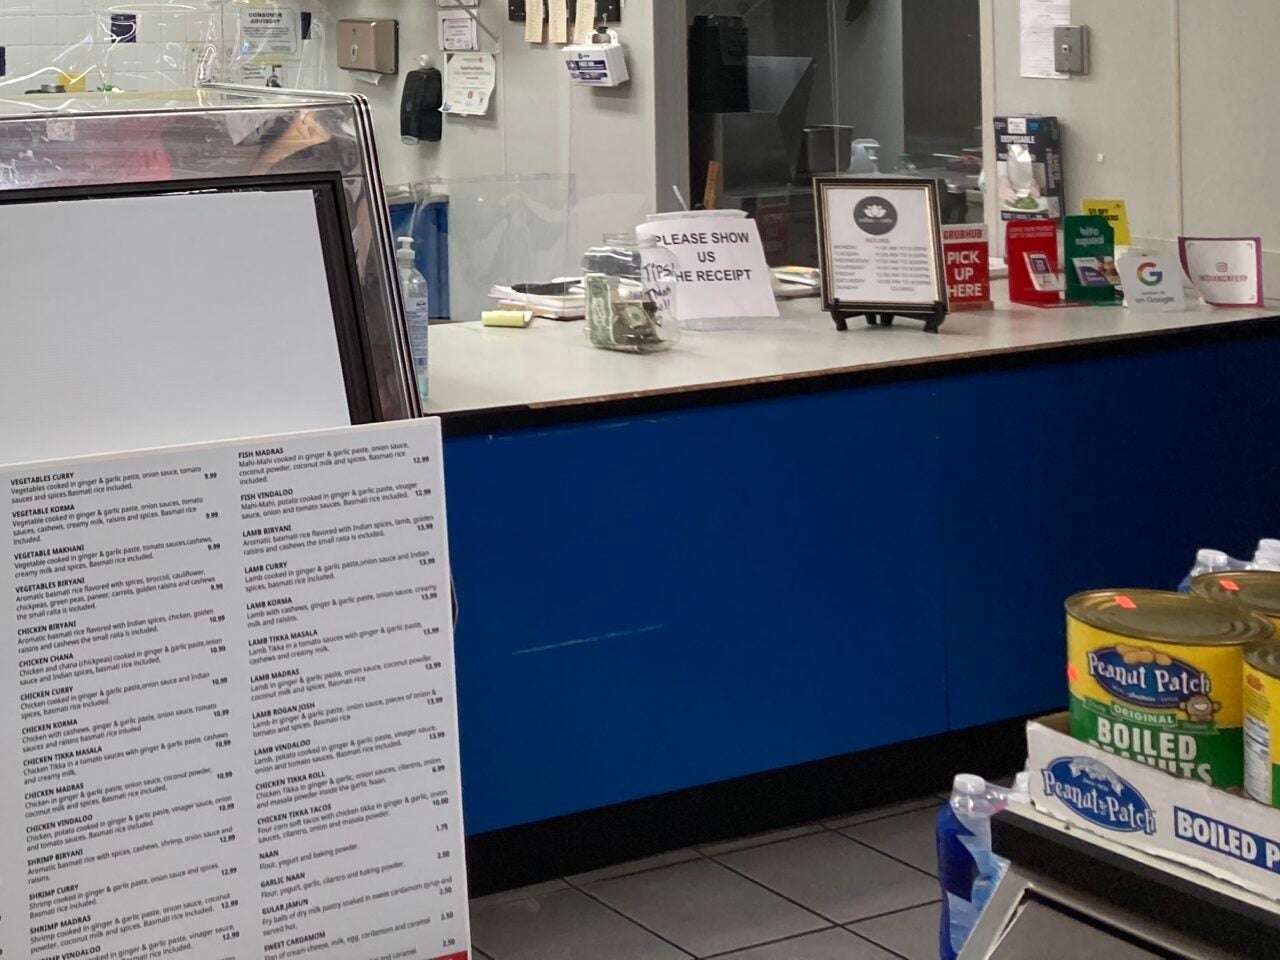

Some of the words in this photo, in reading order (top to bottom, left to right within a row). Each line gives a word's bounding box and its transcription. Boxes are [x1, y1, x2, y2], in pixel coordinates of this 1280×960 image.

[656, 233, 707, 245] PLEASE
[711, 232, 749, 243] SHOW
[943, 229, 983, 239] GRUBHUB
[698, 252, 715, 263] US
[947, 251, 980, 264] PICK
[676, 270, 692, 282] HE
[696, 269, 752, 281] RECEIPT
[954, 268, 974, 281] UP
[946, 284, 982, 297] HERE
[255, 448, 284, 456] MADRAS
[413, 456, 430, 464] 12.99
[11, 475, 51, 486] VEGETABLES
[53, 472, 74, 480] CURRY
[19, 656, 49, 667] CHICKEN
[50, 653, 74, 662] CHANA
[250, 674, 270, 683] LAMB
[271, 668, 300, 678] MADRAS
[1087, 652, 1146, 688] Peanut
[1155, 669, 1211, 694] Patch
[1114, 704, 1173, 724] ORIGINAL
[1097, 717, 1197, 760] BOILED
[1041, 769, 1101, 814] Peanut
[1107, 797, 1156, 834] Patch
[1177, 811, 1258, 860] BOILED
[28, 854, 54, 866] SHRIMP
[55, 849, 83, 860] BIRYANI
[259, 850, 279, 859] NAAN
[260, 876, 284, 888] GARLIC
[286, 872, 305, 882] NAAN
